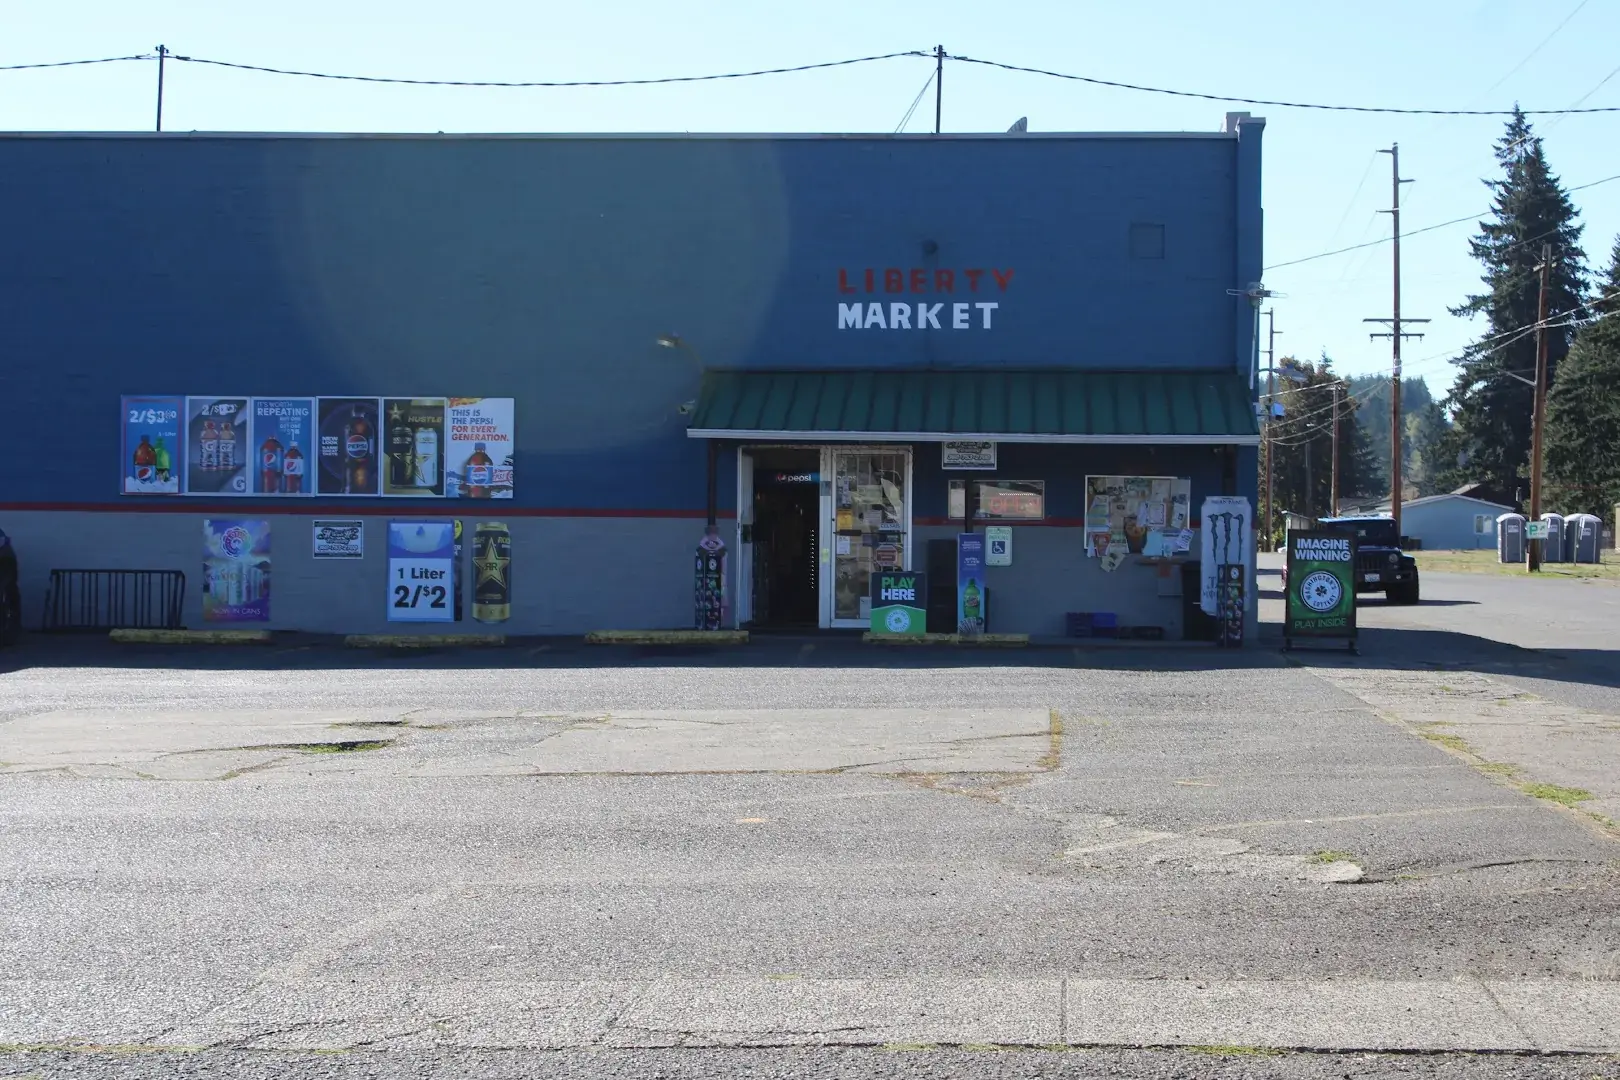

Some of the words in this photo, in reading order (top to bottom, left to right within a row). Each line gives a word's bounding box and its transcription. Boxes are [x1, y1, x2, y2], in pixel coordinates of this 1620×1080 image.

[838, 268, 1015, 294] LIBERTY
[837, 302, 999, 330] MARKET
[257, 407, 309, 416] REPEATING
[407, 415, 444, 423] HUSTLE
[451, 425, 468, 433] FOR
[471, 425, 497, 433] EVERY
[451, 433, 509, 442] GENERATION.
[787, 474, 812, 484] pepsi
[1296, 538, 1350, 550] IMAGINE
[1294, 549, 1352, 561] WINNING
[398, 568, 404, 579] 1
[411, 567, 445, 579] Liter
[881, 577, 916, 588] PLAY
[1304, 575, 1337, 600] WASHINGTON'S
[394, 585, 446, 608] 2/$2
[881, 588, 916, 600] HERE
[1313, 595, 1337, 608] LOTTERY
[1294, 620, 1316, 629] PLAY
[1318, 618, 1347, 628] INSIDE
